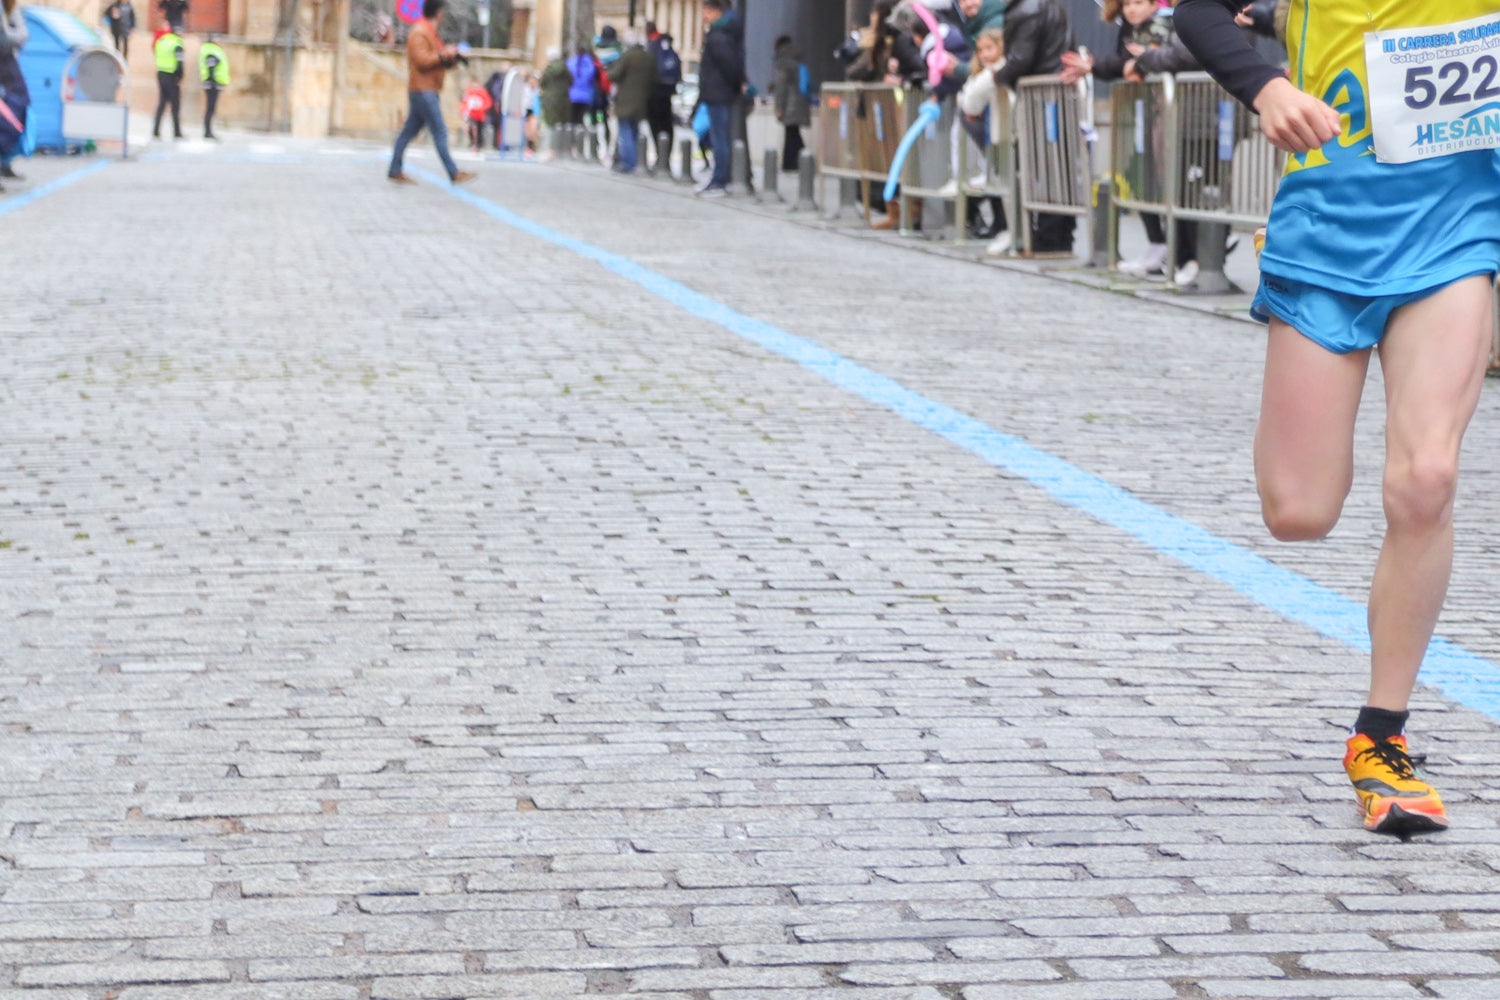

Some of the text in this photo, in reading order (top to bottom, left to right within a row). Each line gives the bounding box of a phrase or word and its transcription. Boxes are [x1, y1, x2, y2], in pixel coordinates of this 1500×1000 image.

[1382, 38, 1396, 53] III
[1398, 31, 1456, 51] CARRERA
[1390, 51, 1434, 64] Colegio
[1436, 44, 1480, 60] Maestro
[1404, 54, 1500, 110] 522
[1415, 113, 1500, 146] HESAN
